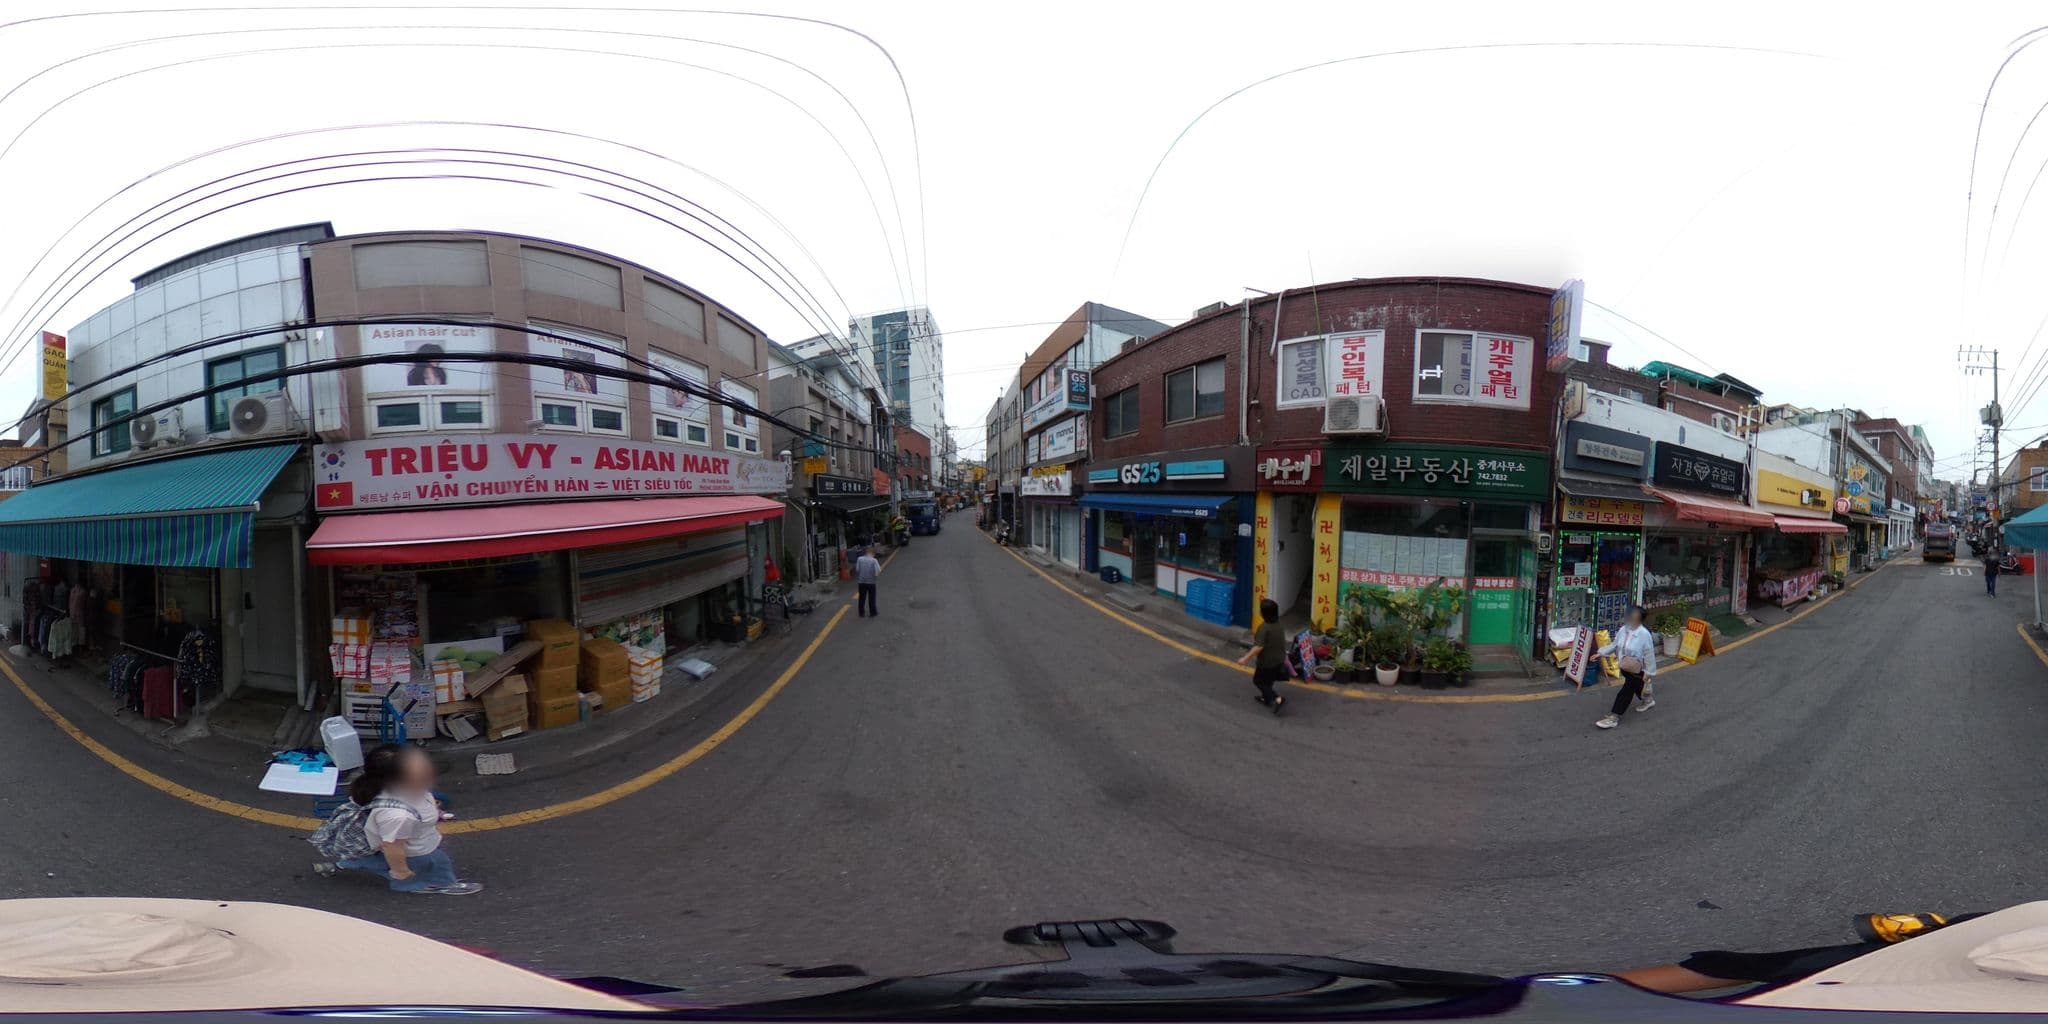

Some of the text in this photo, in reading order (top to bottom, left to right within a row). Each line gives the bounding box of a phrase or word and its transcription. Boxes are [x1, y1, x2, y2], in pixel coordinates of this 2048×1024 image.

[372, 326, 476, 340] Asian hair cut
[1341, 335, 1366, 382] 부인복
[1071, 372, 1086, 383] GS
[1071, 382, 1086, 392] 25
[1290, 387, 1321, 399] CAD
[365, 439, 488, 480] TRIỆU
[505, 442, 558, 469] VY
[594, 447, 675, 472] ASIAN
[683, 453, 730, 475] MART
[1340, 455, 1474, 484] 제일부동산
[1477, 460, 1526, 472] 중개사무소
[1121, 461, 1161, 484] GS25
[416, 481, 458, 501] VẬN
[612, 477, 640, 495] VIỆT
[645, 476, 671, 490] SIÊU
[674, 477, 693, 490] TỐC
[392, 491, 411, 501] 슈퍼
[1194, 509, 1209, 517] GS25
[1939, 567, 1973, 576] 30
